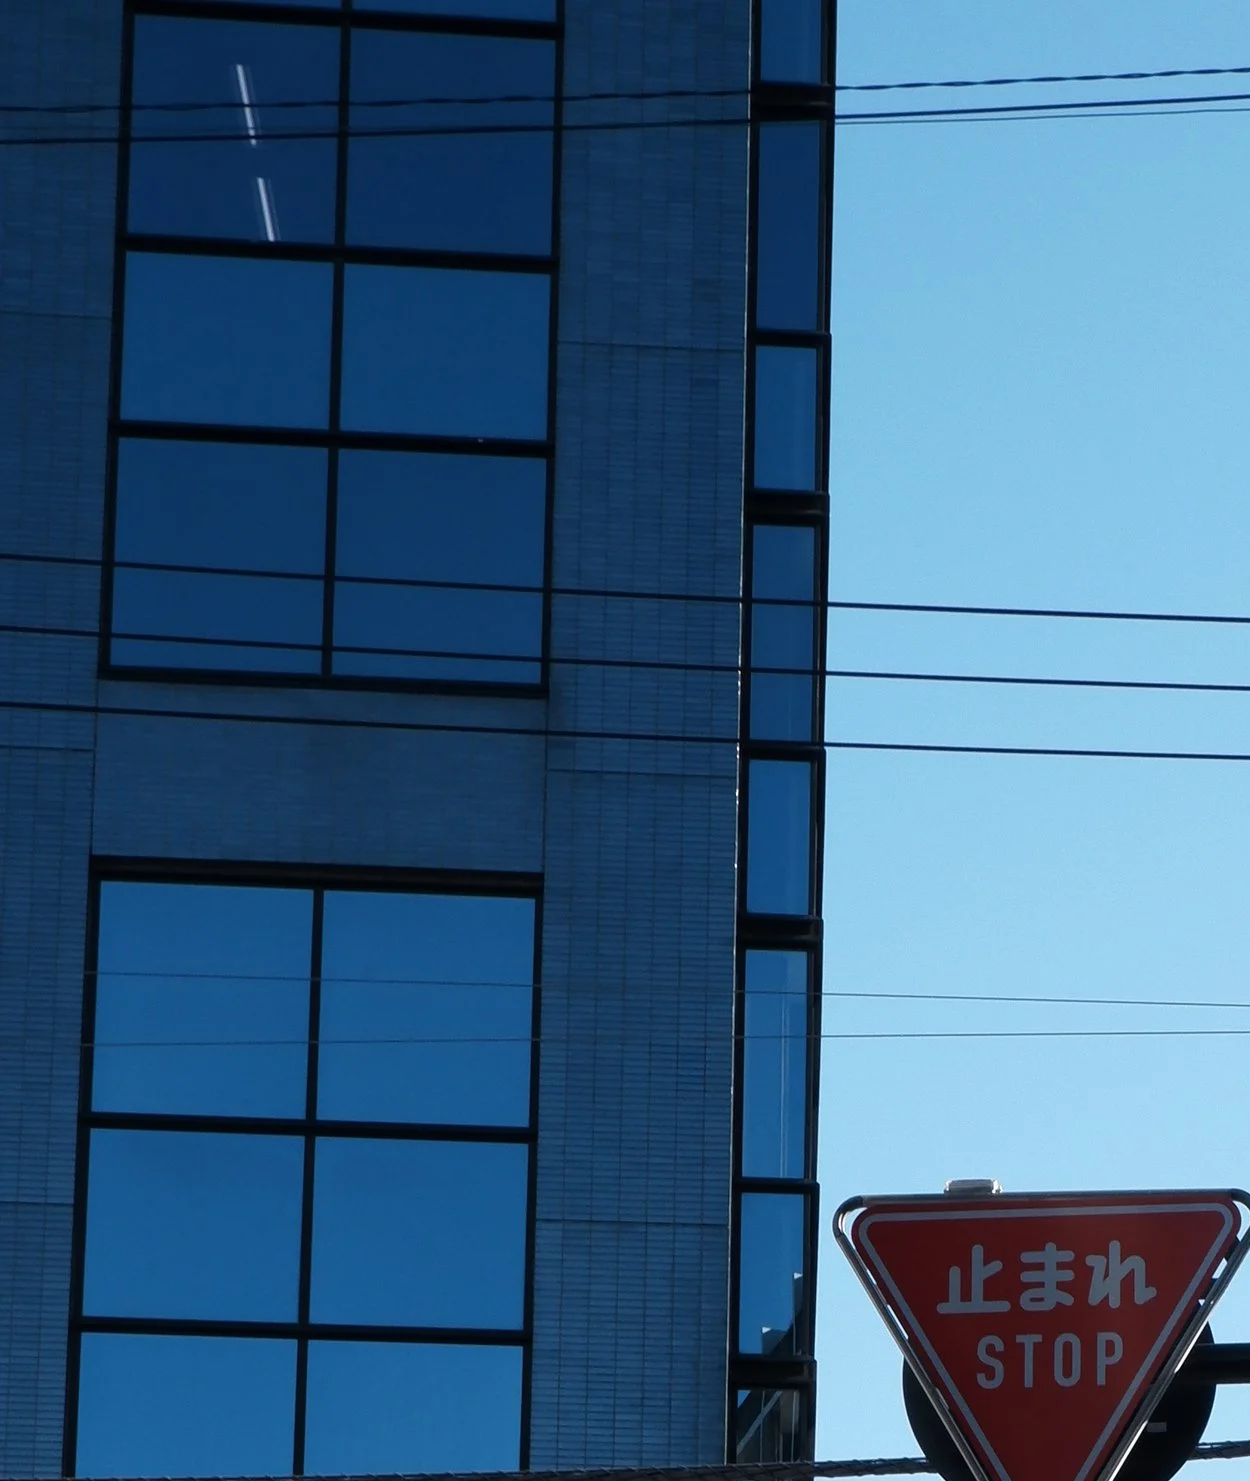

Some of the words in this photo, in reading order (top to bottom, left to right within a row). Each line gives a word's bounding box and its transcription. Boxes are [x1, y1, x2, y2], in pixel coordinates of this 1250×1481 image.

[936, 1239, 1158, 1315] 止まれ
[976, 1332, 1124, 1390] STOP
